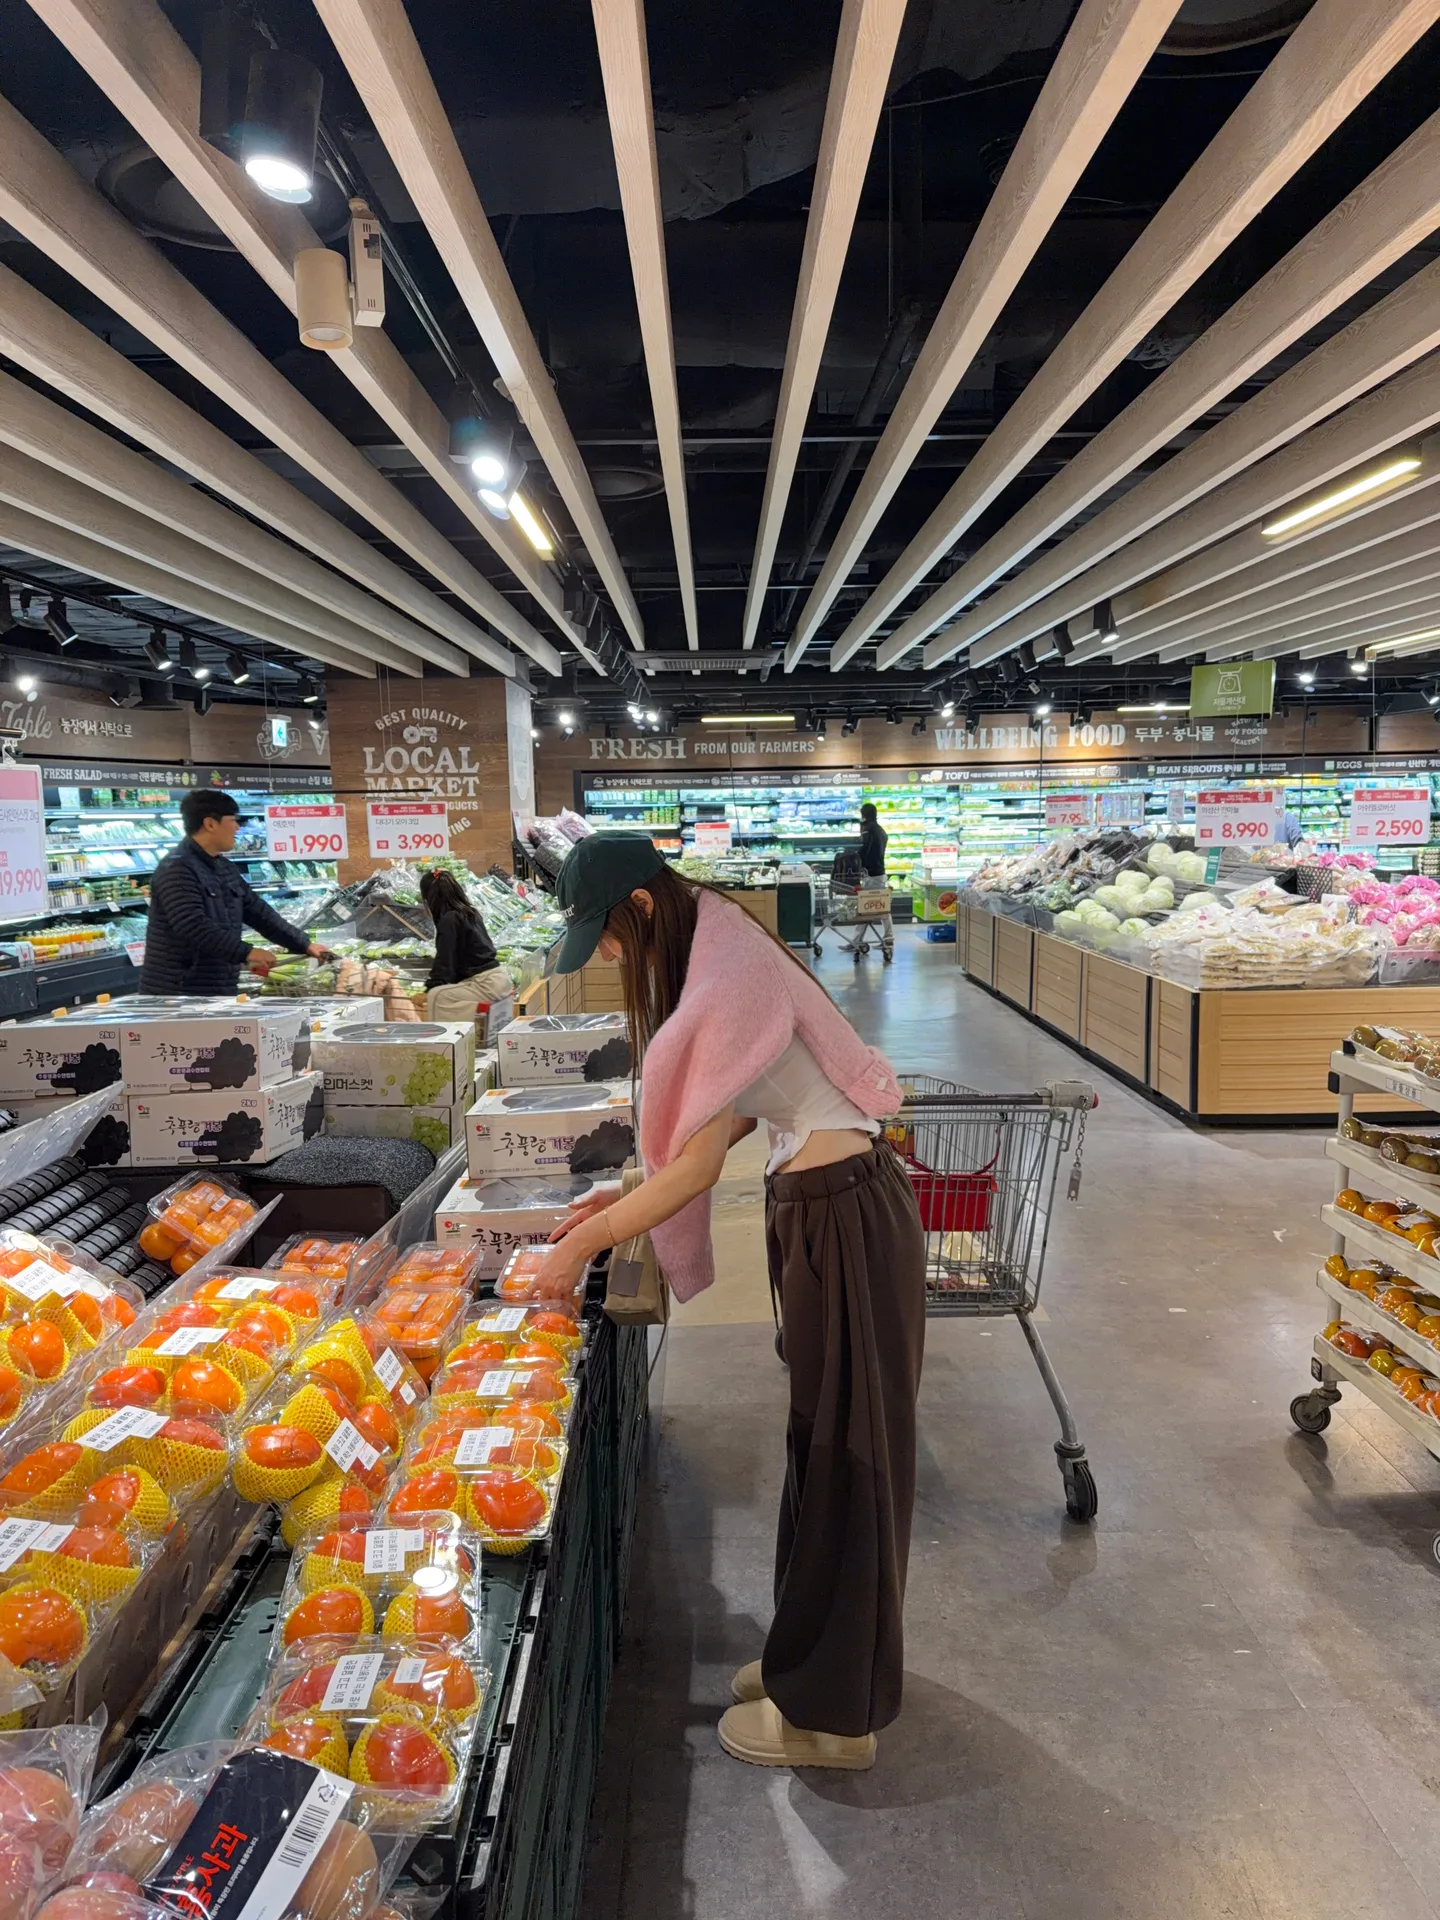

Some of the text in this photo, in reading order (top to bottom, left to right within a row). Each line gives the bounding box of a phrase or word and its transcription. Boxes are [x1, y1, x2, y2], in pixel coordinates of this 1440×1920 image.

[61, 718, 133, 738] 농장에서 식탁으로
[375, 708, 468, 731] BEST QUALITY
[935, 724, 1126, 750] WELLBEING FOOD
[1231, 736, 1260, 746] HEALTHY
[589, 738, 816, 759] FRESH FROM OUR FARMERS
[363, 747, 480, 774] LOCAL
[1156, 766, 1180, 774] BEAN
[1182, 764, 1223, 773] SPROUTS
[1336, 761, 1362, 769] EGGS
[43, 768, 73, 780] FRESH
[74, 769, 102, 780] SALAD
[945, 771, 970, 780] TOFU
[364, 776, 480, 797] MARKET
[447, 801, 478, 810] DUCTS
[1221, 822, 1268, 839] 8,990
[1375, 819, 1423, 836] 2,590
[289, 834, 343, 854] 1,990
[398, 834, 444, 850] 3,990
[864, 901, 885, 910] OPEN
[99, 1031, 115, 1039] 2kg
[234, 1026, 251, 1034] 2kg
[17, 1049, 58, 1068] 추풍령
[151, 1043, 192, 1062] 추풍령
[521, 1047, 564, 1067] 추풍령
[323, 1078, 373, 1091] 인머스켓
[241, 1099, 257, 1107] 2kg
[160, 1116, 200, 1135] 추풍령
[612, 1116, 628, 1124] 2kg
[493, 1132, 576, 1157] 추풍령 거봉
[471, 1228, 521, 1254] 추풍령
[86, 1411, 134, 1442] 알이 크고 달콤한
[331, 1426, 353, 1456] 알이 크고 달콤한
[372, 1536, 385, 1569] 알이 크고 달콤한
[331, 1660, 358, 1704] 알이 크고 달콤한
[351, 1683, 366, 1694] 먹는
[347, 1697, 361, 1708] 바로
[172, 1855, 194, 1883] APPLE
[176, 1822, 248, 1920] 홍사과
